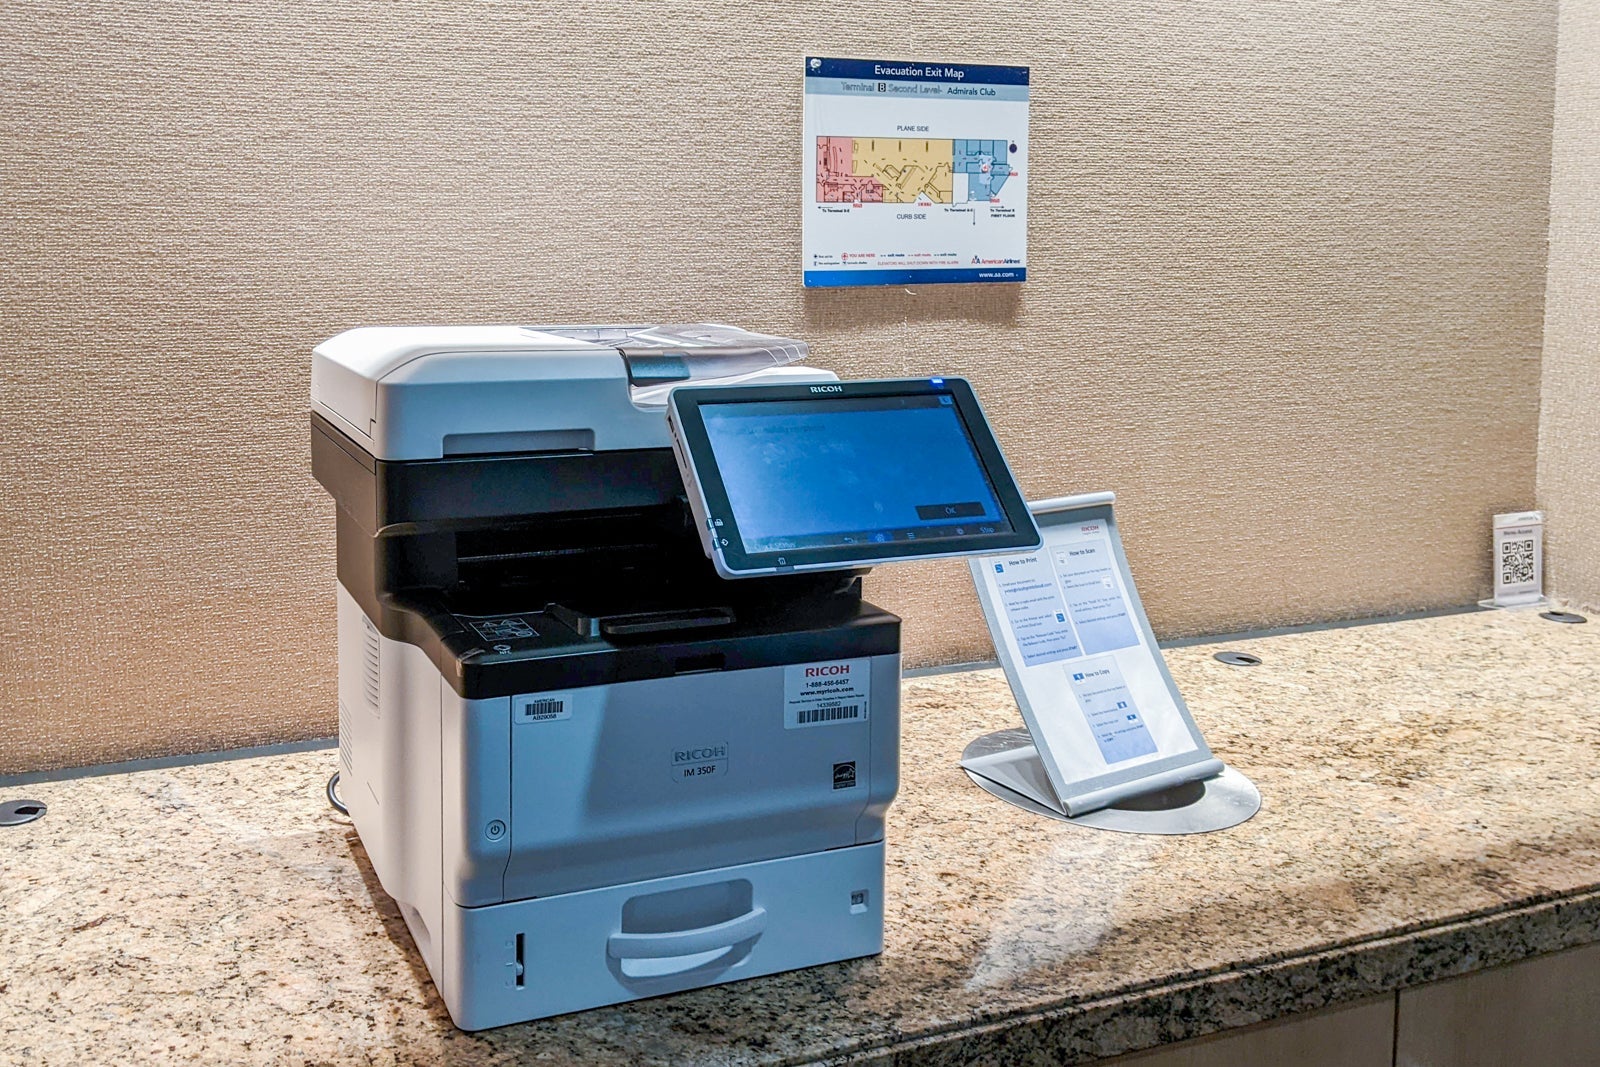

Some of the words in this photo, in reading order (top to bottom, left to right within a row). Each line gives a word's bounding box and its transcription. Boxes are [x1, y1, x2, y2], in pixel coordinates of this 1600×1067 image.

[874, 65, 923, 77] Evacuation
[925, 67, 942, 77] Exit
[944, 68, 965, 80] Map
[841, 81, 875, 92] Terminal
[888, 83, 918, 94] Second
[947, 86, 978, 96] Admirals
[980, 87, 996, 97] Club
[810, 385, 843, 393] RICOH
[945, 506, 957, 514] OK
[980, 526, 995, 534] Stop
[805, 665, 850, 677] RICOH
[800, 687, 854, 696] www.myricoh.com
[674, 746, 725, 762] RICOH
[683, 768, 695, 778] IM
[697, 765, 716, 776] 350F
